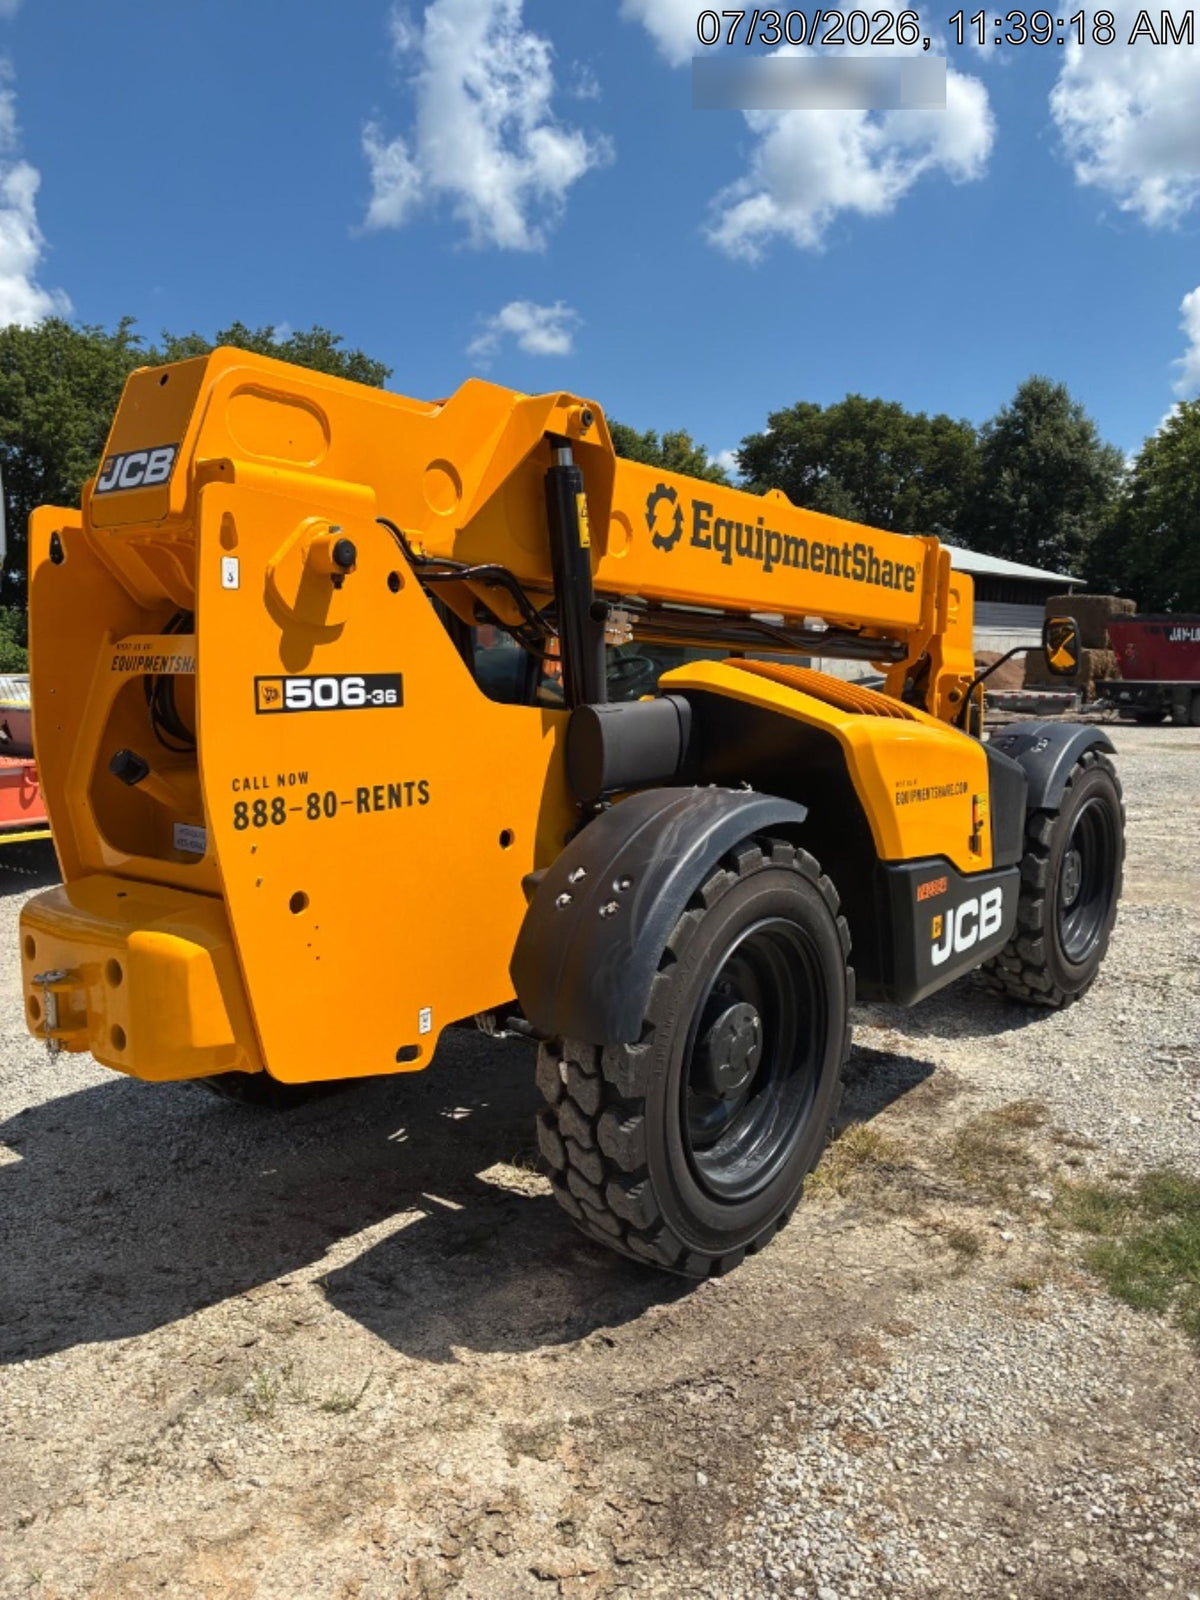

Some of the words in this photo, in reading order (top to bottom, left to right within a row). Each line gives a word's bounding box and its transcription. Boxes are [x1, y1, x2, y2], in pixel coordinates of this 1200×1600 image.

[98, 447, 175, 491] JCB
[690, 499, 915, 592] EquipmentShare
[285, 677, 397, 708] 506-36
[232, 776, 270, 792] CALL
[277, 771, 309, 787] NOW
[233, 780, 430, 831] 888-80-RENTS
[931, 886, 1003, 966] JCB
